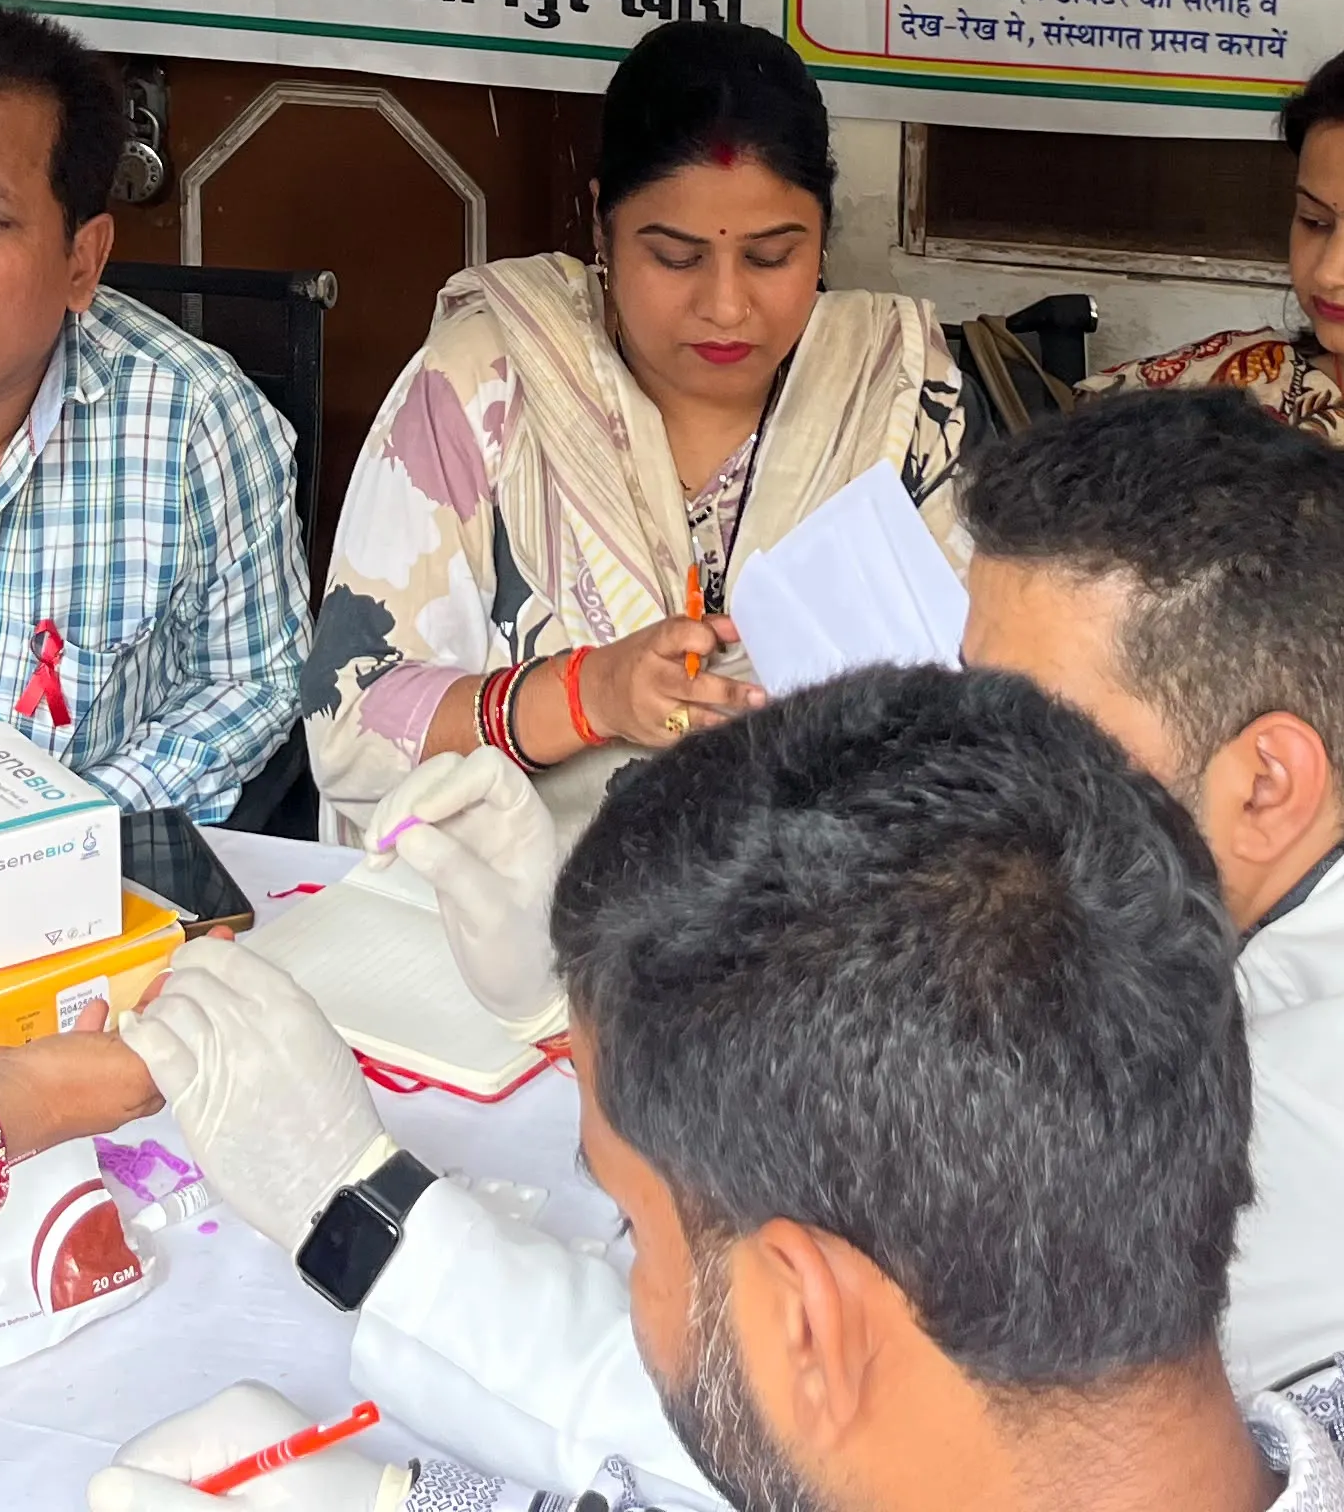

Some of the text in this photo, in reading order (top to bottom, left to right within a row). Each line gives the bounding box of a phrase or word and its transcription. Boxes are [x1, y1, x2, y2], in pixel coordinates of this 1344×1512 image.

[898, 4, 999, 41] देख-रेख
[1041, 16, 1143, 51] संस्थागत
[1148, 28, 1210, 54] प्रसव
[1215, 27, 1288, 59] करायें
[92, 1265, 139, 1292] 20 GM.
